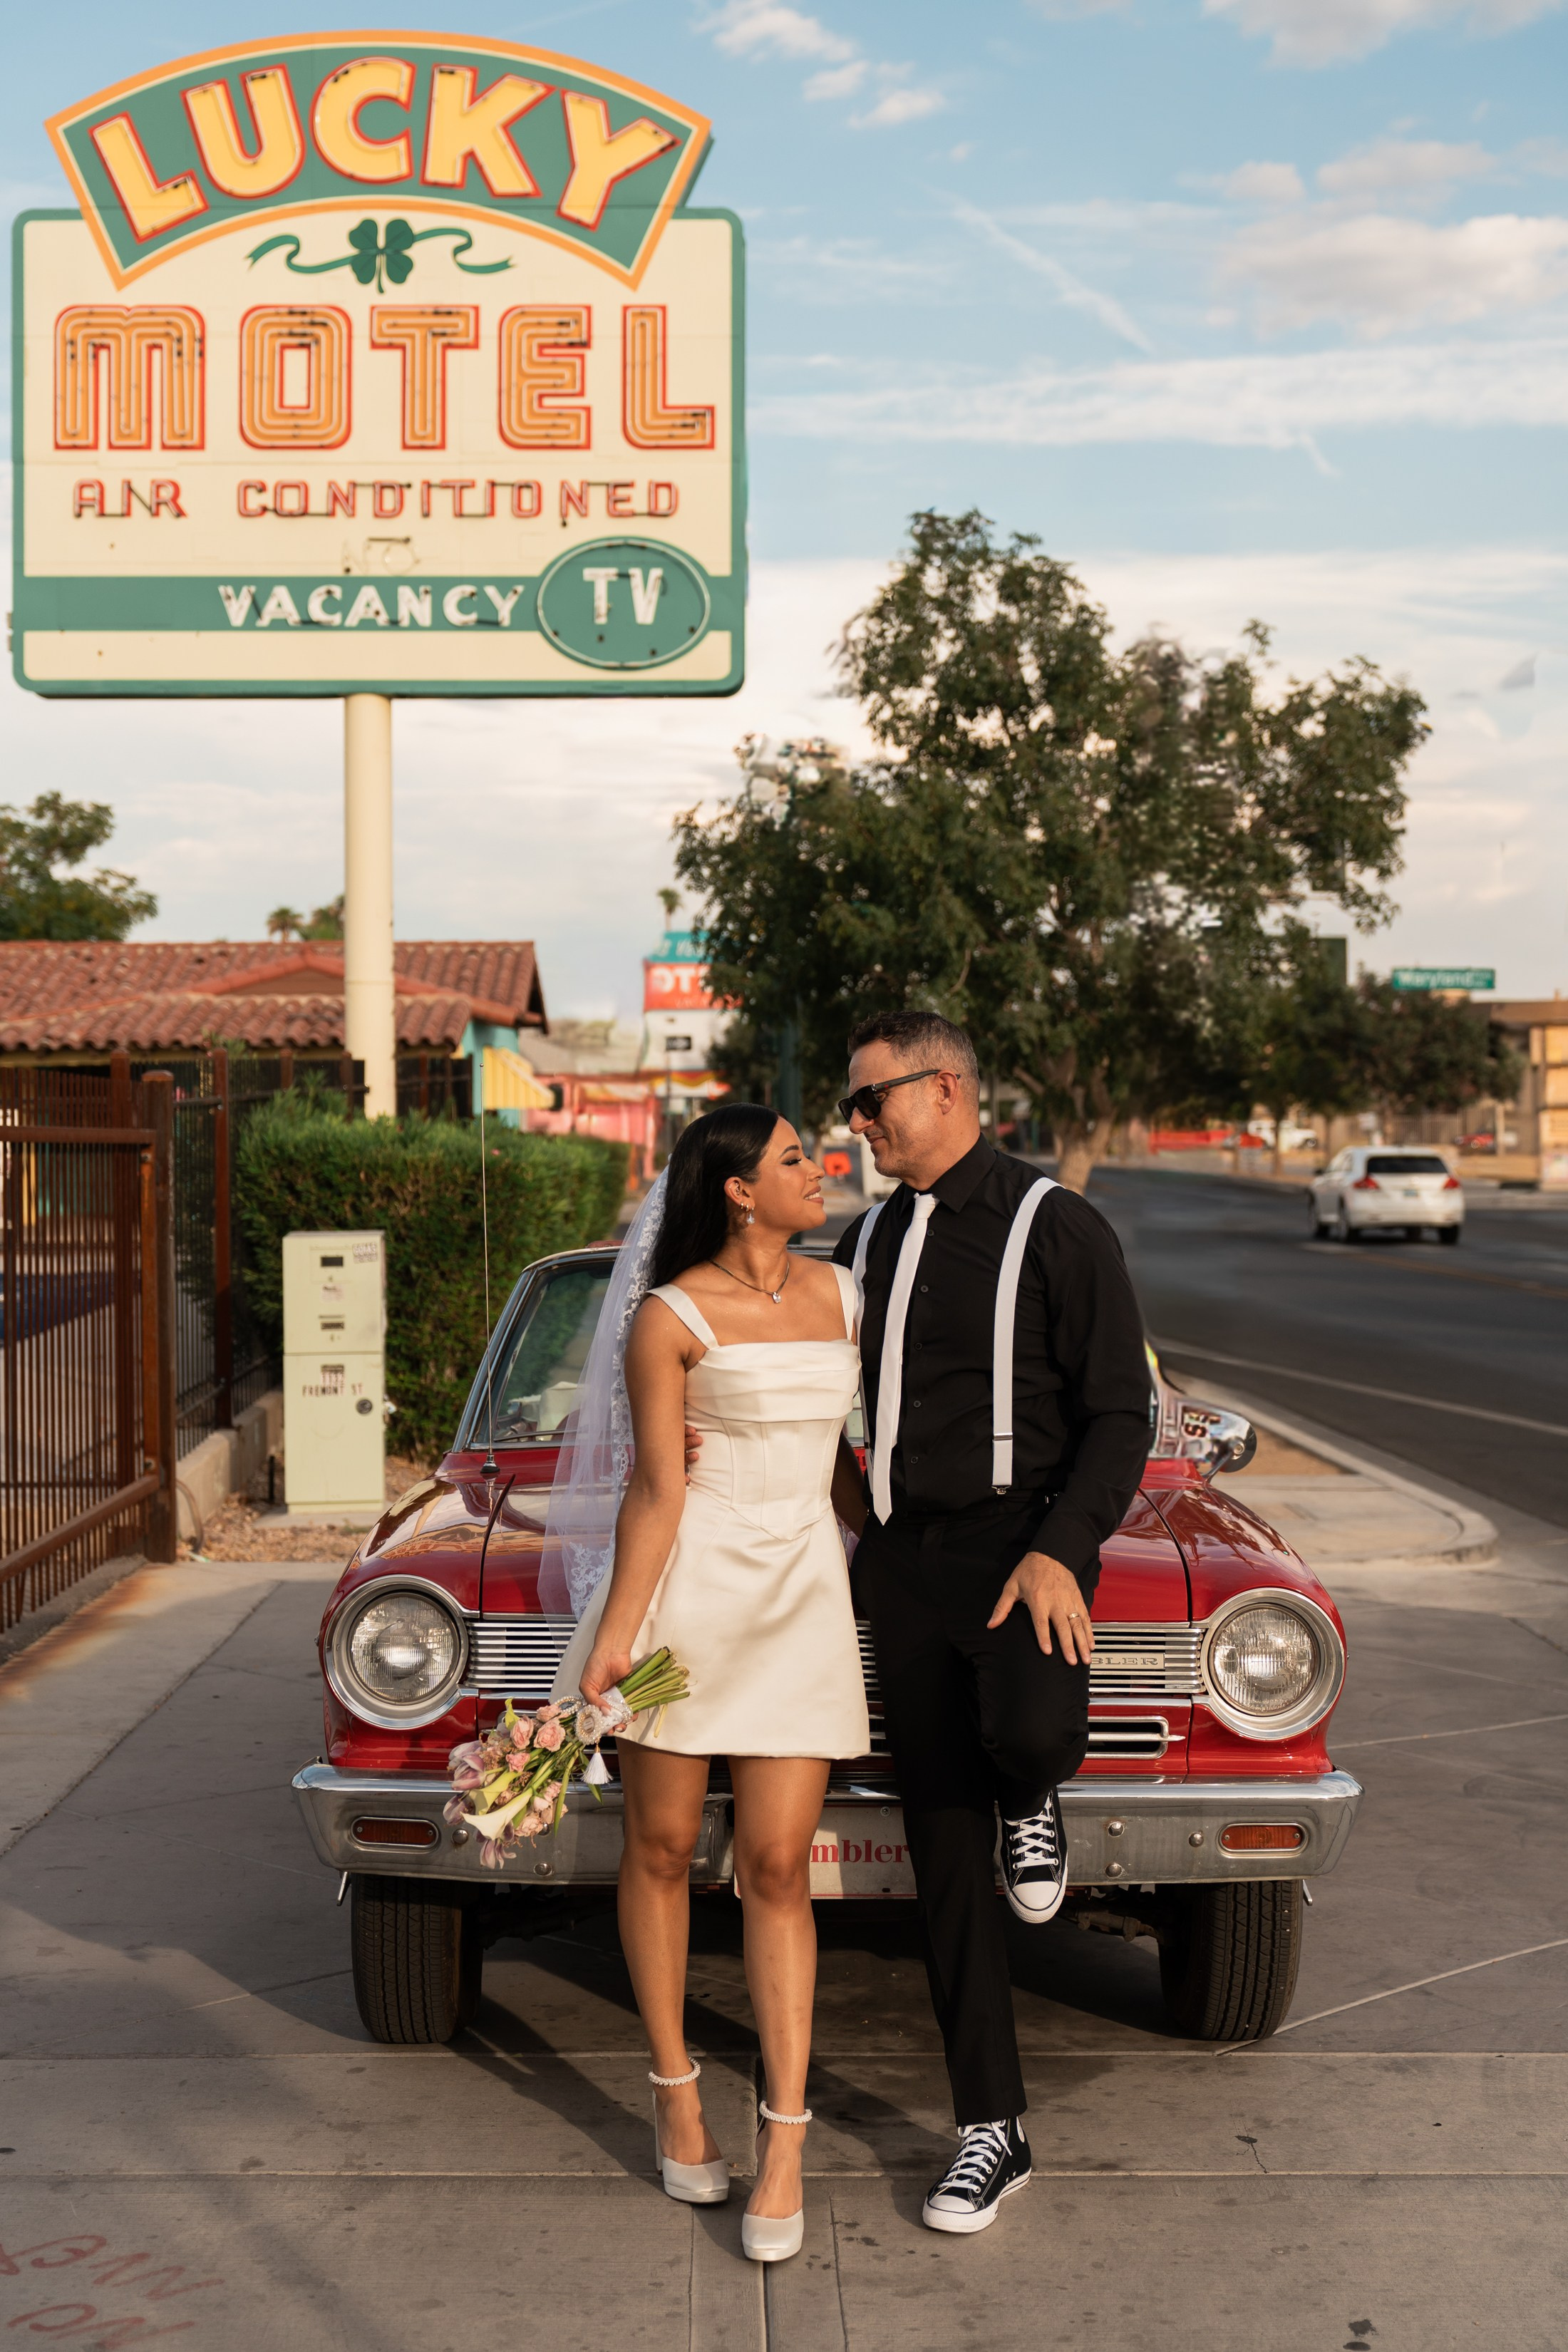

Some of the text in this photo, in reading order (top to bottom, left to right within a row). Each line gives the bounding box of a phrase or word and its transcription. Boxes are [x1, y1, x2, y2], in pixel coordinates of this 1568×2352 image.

[88, 56, 682, 244] LUCKY
[53, 304, 716, 451] MOTEL
[73, 479, 679, 518] AIR CONDITIONED
[219, 584, 525, 628] VACANCY
[582, 567, 664, 626] TV
[810, 1840, 909, 1863] mbler
